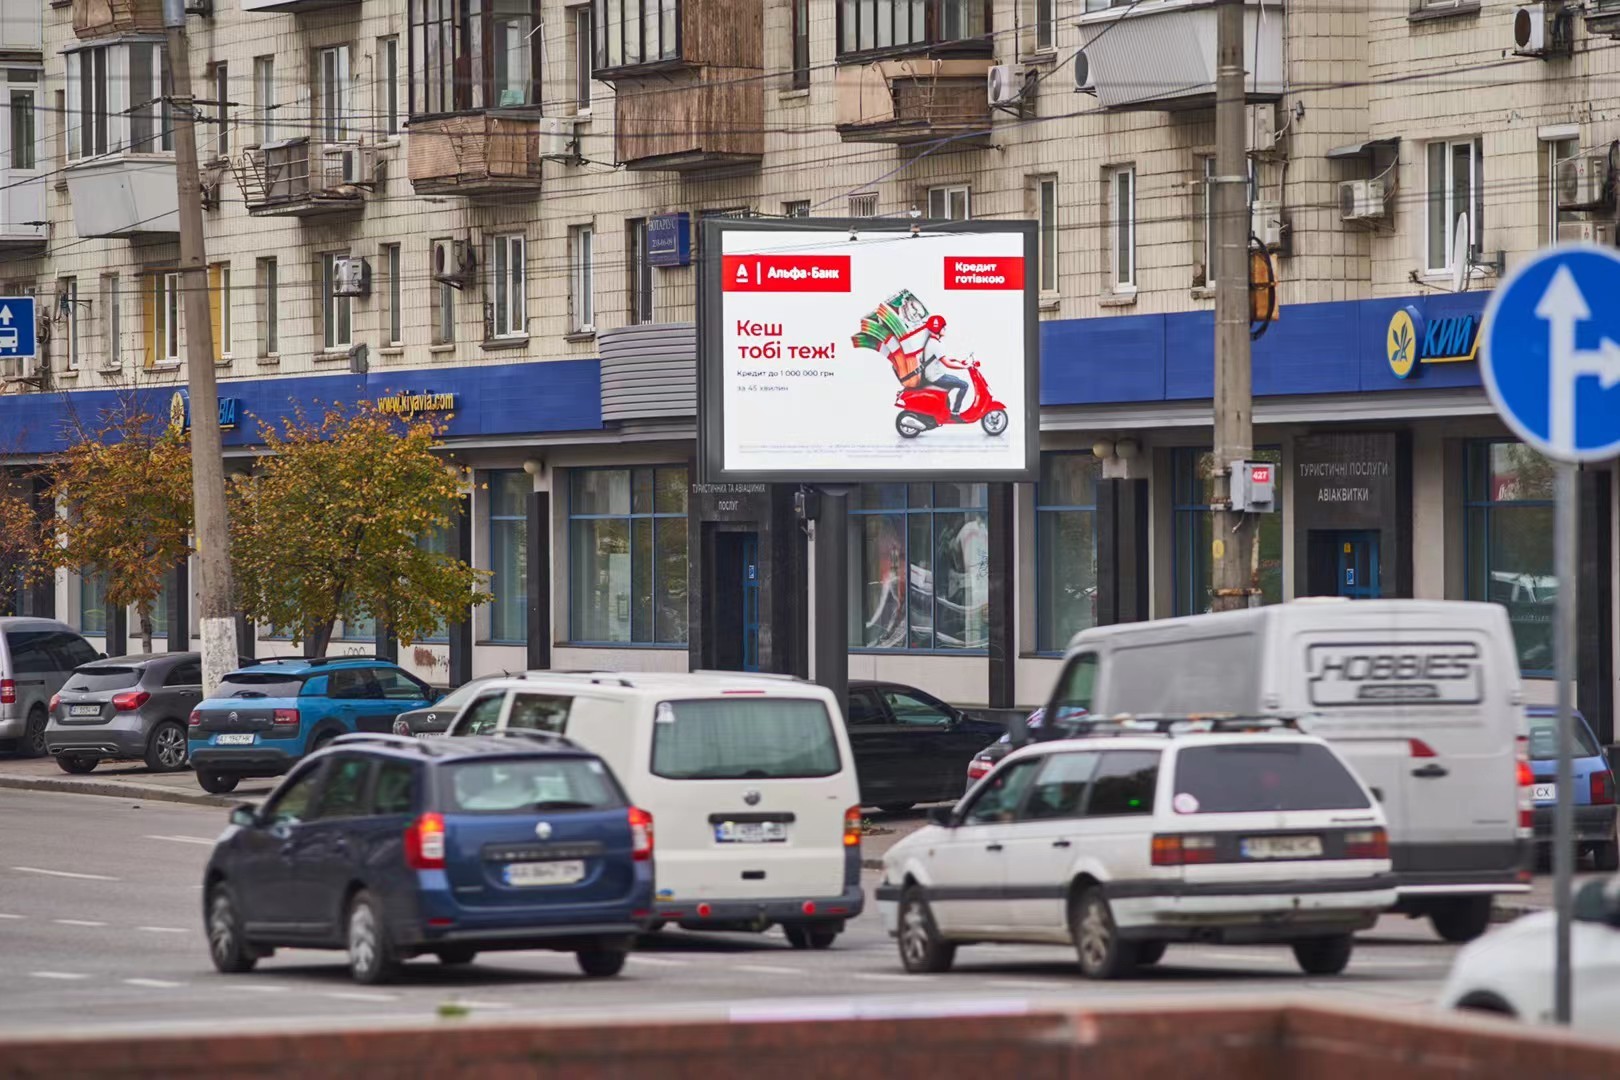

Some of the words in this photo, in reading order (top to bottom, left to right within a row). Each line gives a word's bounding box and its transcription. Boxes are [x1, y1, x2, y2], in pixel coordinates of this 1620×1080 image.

[955, 262, 997, 273] Кредит
[955, 274, 1006, 284] готівкою
[737, 320, 783, 336] Кеш
[738, 341, 781, 359] тобі
[787, 342, 836, 359] теж!
[736, 370, 766, 378] Кредит
[1252, 470, 1268, 480] 427
[1300, 463, 1348, 477] ТУРИСТИЧНІ
[1349, 462, 1389, 476] ПОСЛУГИ
[1317, 487, 1369, 502] АВІАКВИТКИ
[1321, 654, 1473, 681] HOBBIES
